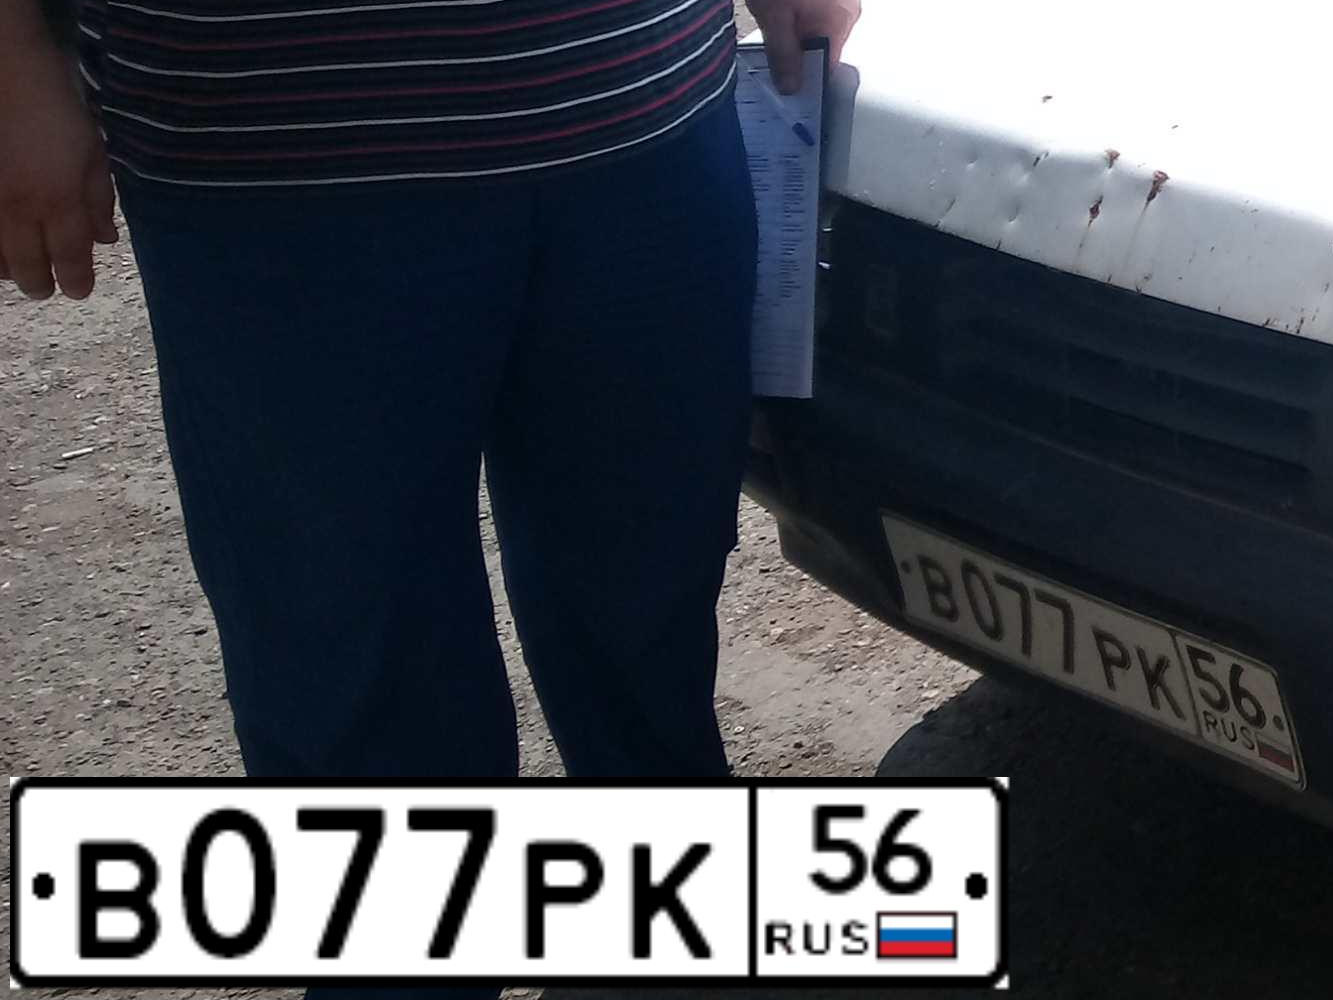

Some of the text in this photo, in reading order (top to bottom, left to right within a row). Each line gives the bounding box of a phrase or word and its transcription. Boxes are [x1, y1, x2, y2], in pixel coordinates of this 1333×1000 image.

[917, 553, 1267, 730] В077РК 56
[1204, 710, 1256, 750] RUS
